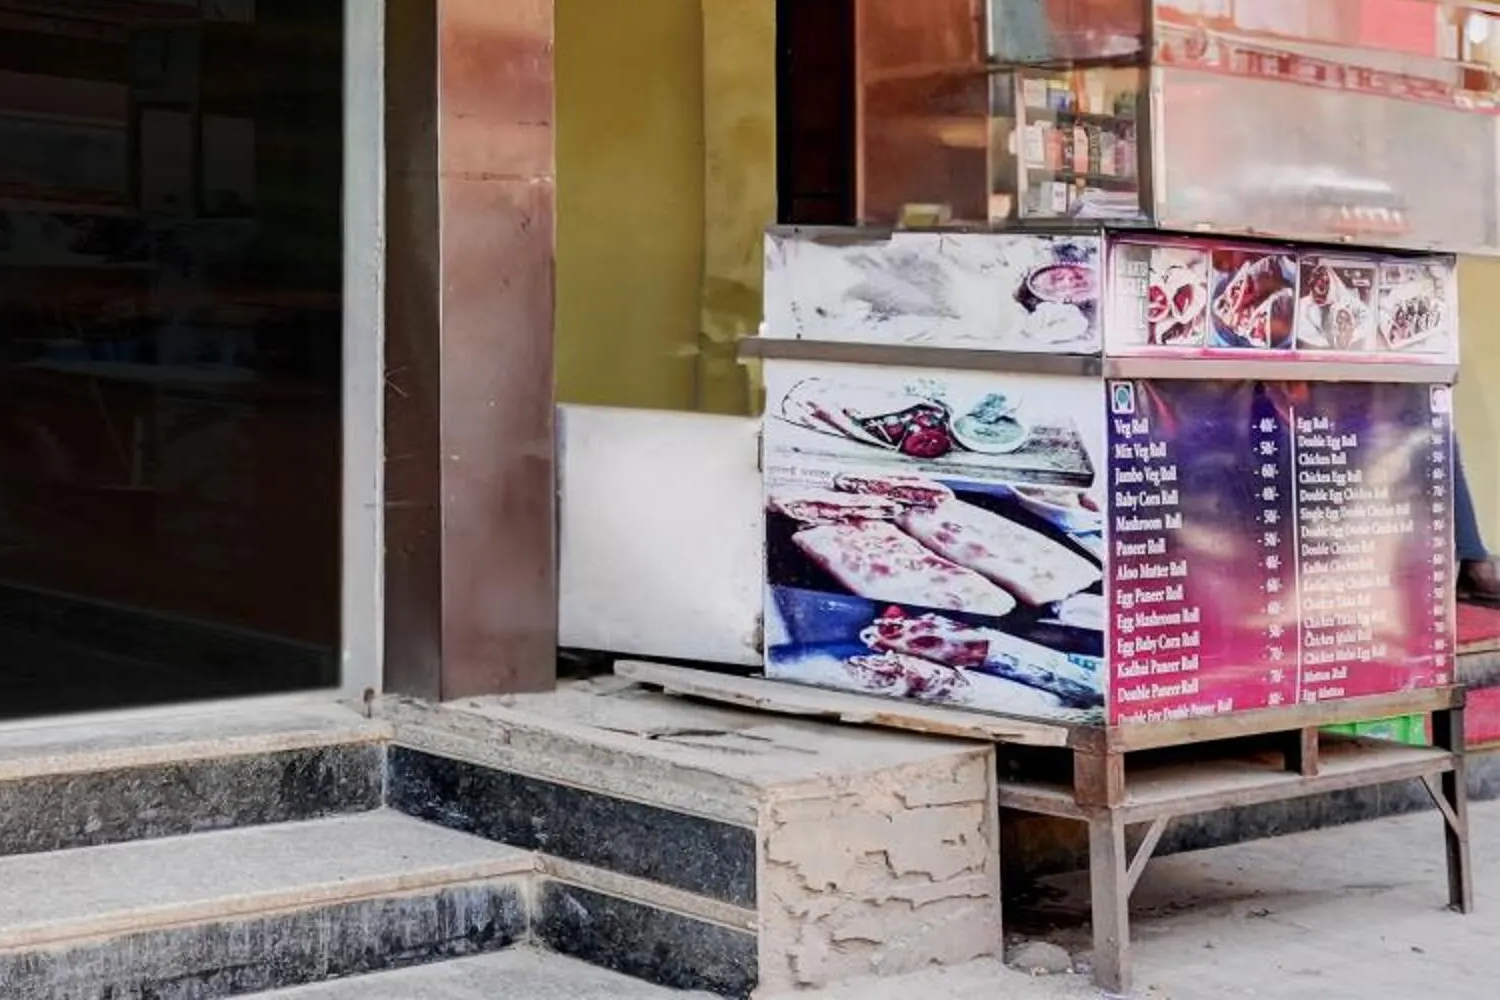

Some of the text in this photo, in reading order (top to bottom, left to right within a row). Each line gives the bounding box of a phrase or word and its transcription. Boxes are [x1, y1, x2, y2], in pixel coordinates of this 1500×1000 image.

[1115, 420, 1131, 438] Veg
[1132, 418, 1148, 433] Roll
[1313, 417, 1328, 429] Roll
[1342, 434, 1357, 446] Roll
[1134, 443, 1149, 462] Veg
[1150, 442, 1166, 457] Roll
[1116, 467, 1143, 486] Jumbo
[1143, 468, 1160, 486] Veg
[1160, 465, 1176, 481] Roll
[1116, 493, 1137, 511] Baby
[1139, 492, 1160, 506] Corn
[1162, 490, 1178, 505] Roll
[1164, 512, 1182, 528] Roll
[1116, 541, 1147, 556] Paneer
[1148, 538, 1165, 554] Roll
[1116, 565, 1139, 580] Aloo
[1170, 560, 1187, 576] Roll
[1117, 590, 1134, 608] Egg
[1135, 587, 1164, 603] Paneer
[1166, 585, 1183, 601] Roll
[1117, 614, 1134, 633] Egg
[1182, 607, 1199, 623] Roll
[1117, 638, 1134, 657] Egg
[1135, 636, 1157, 653] Baby
[1159, 634, 1180, 649] Corn
[1182, 631, 1199, 647] Roll
[1150, 658, 1180, 674] Paneer
[1182, 655, 1198, 671] Roll
[1118, 684, 1149, 702] Double
[1151, 681, 1182, 698] Paneer
[1182, 678, 1198, 694] Roll
